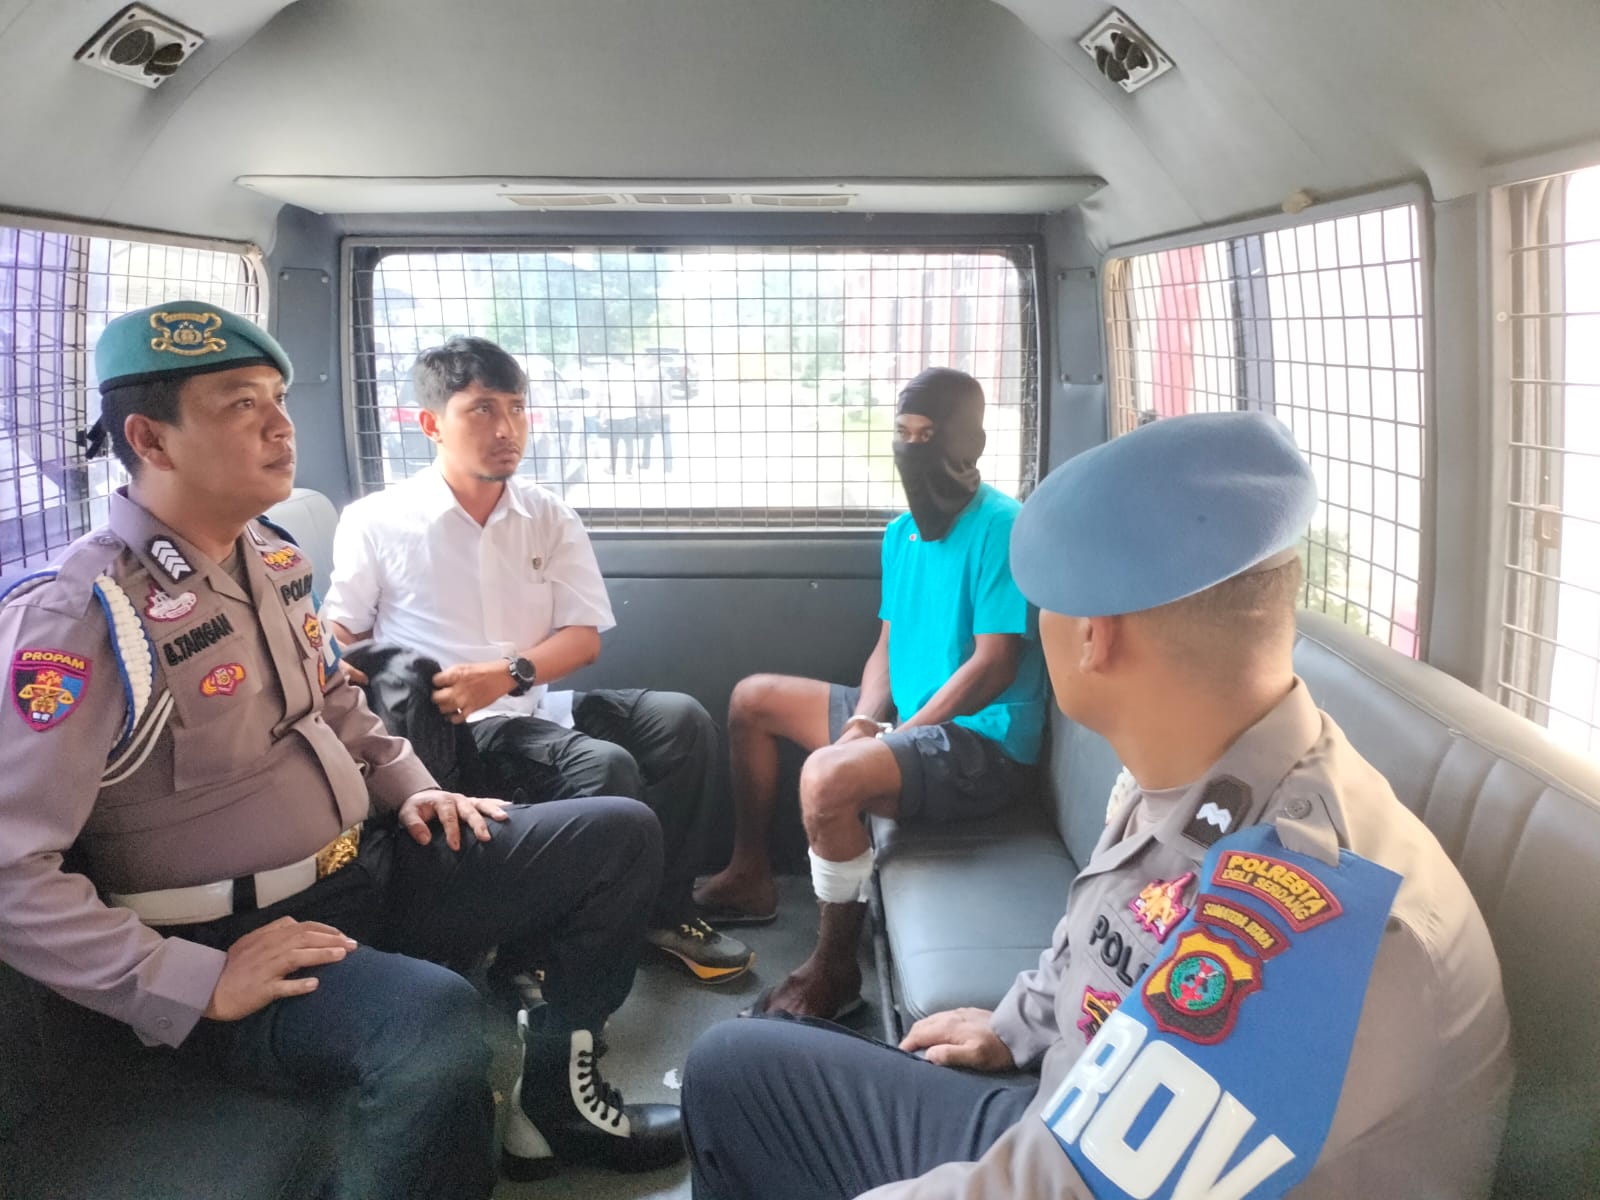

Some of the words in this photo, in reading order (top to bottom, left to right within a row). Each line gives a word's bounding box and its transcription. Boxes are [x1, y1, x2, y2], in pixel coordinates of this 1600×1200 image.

[22, 652, 85, 670] PROPAM
[1221, 869, 1253, 883] DELI
[1254, 877, 1310, 920] SERDANG
[1228, 855, 1327, 915] POLRESTA
